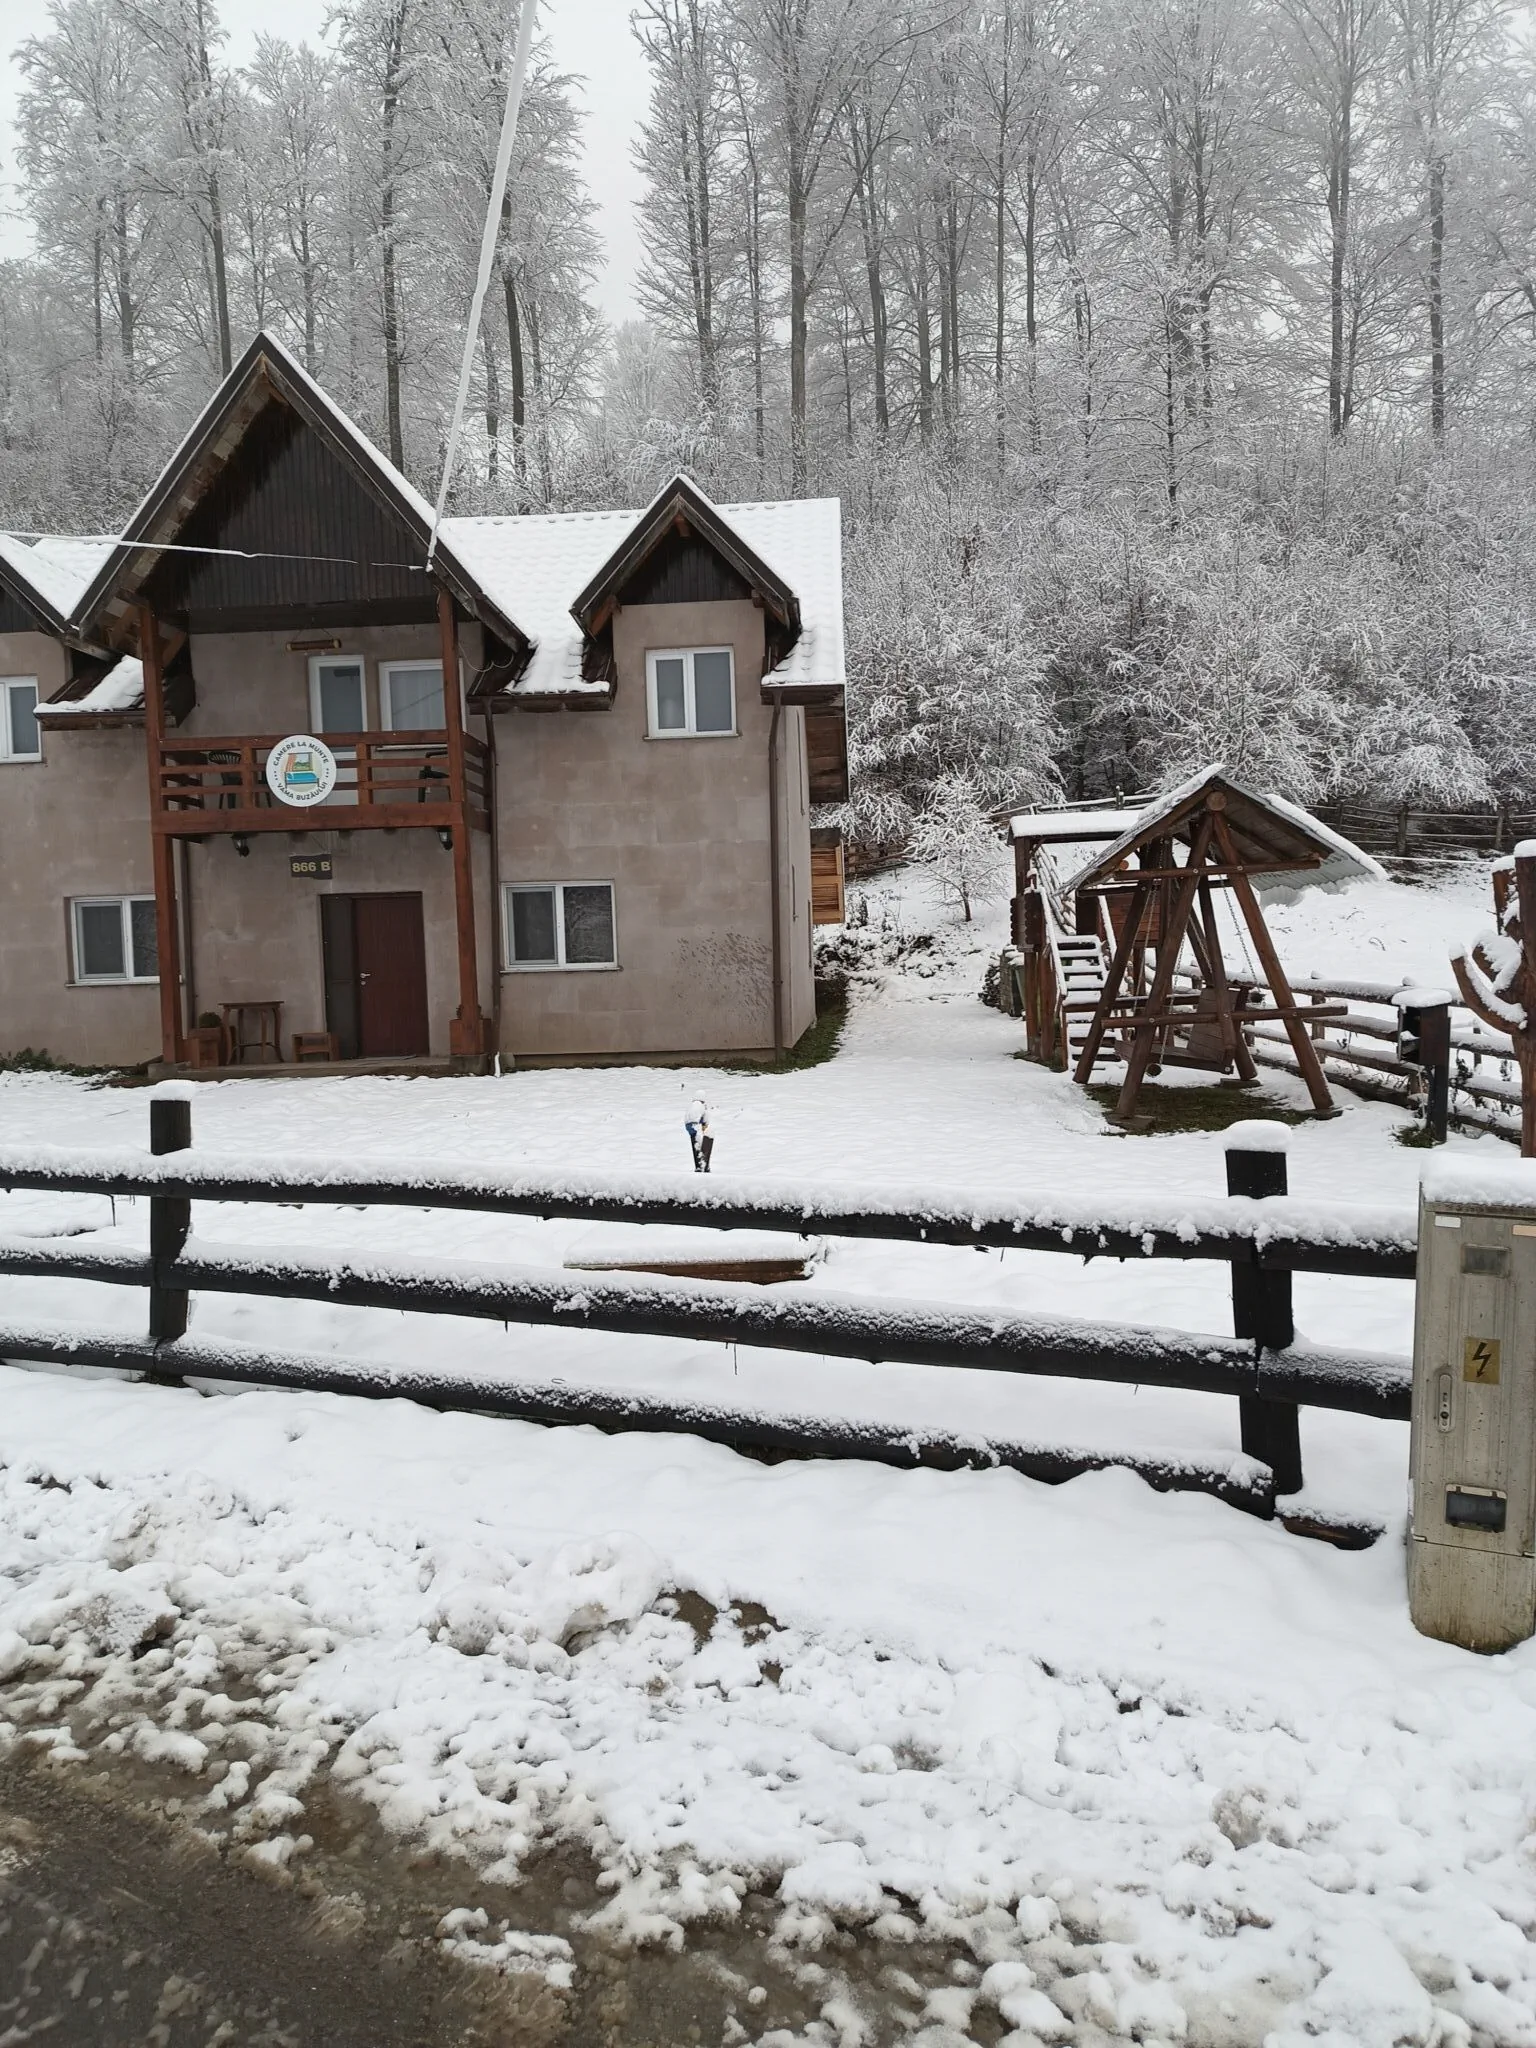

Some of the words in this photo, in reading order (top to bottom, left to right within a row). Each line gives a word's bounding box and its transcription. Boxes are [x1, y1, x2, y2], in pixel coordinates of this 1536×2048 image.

[273, 742, 295, 766] CAMERE
[309, 743, 329, 763] MUNTE
[277, 783, 294, 799] VAMA
[292, 862, 317, 873] 866
[321, 861, 331, 872] B
